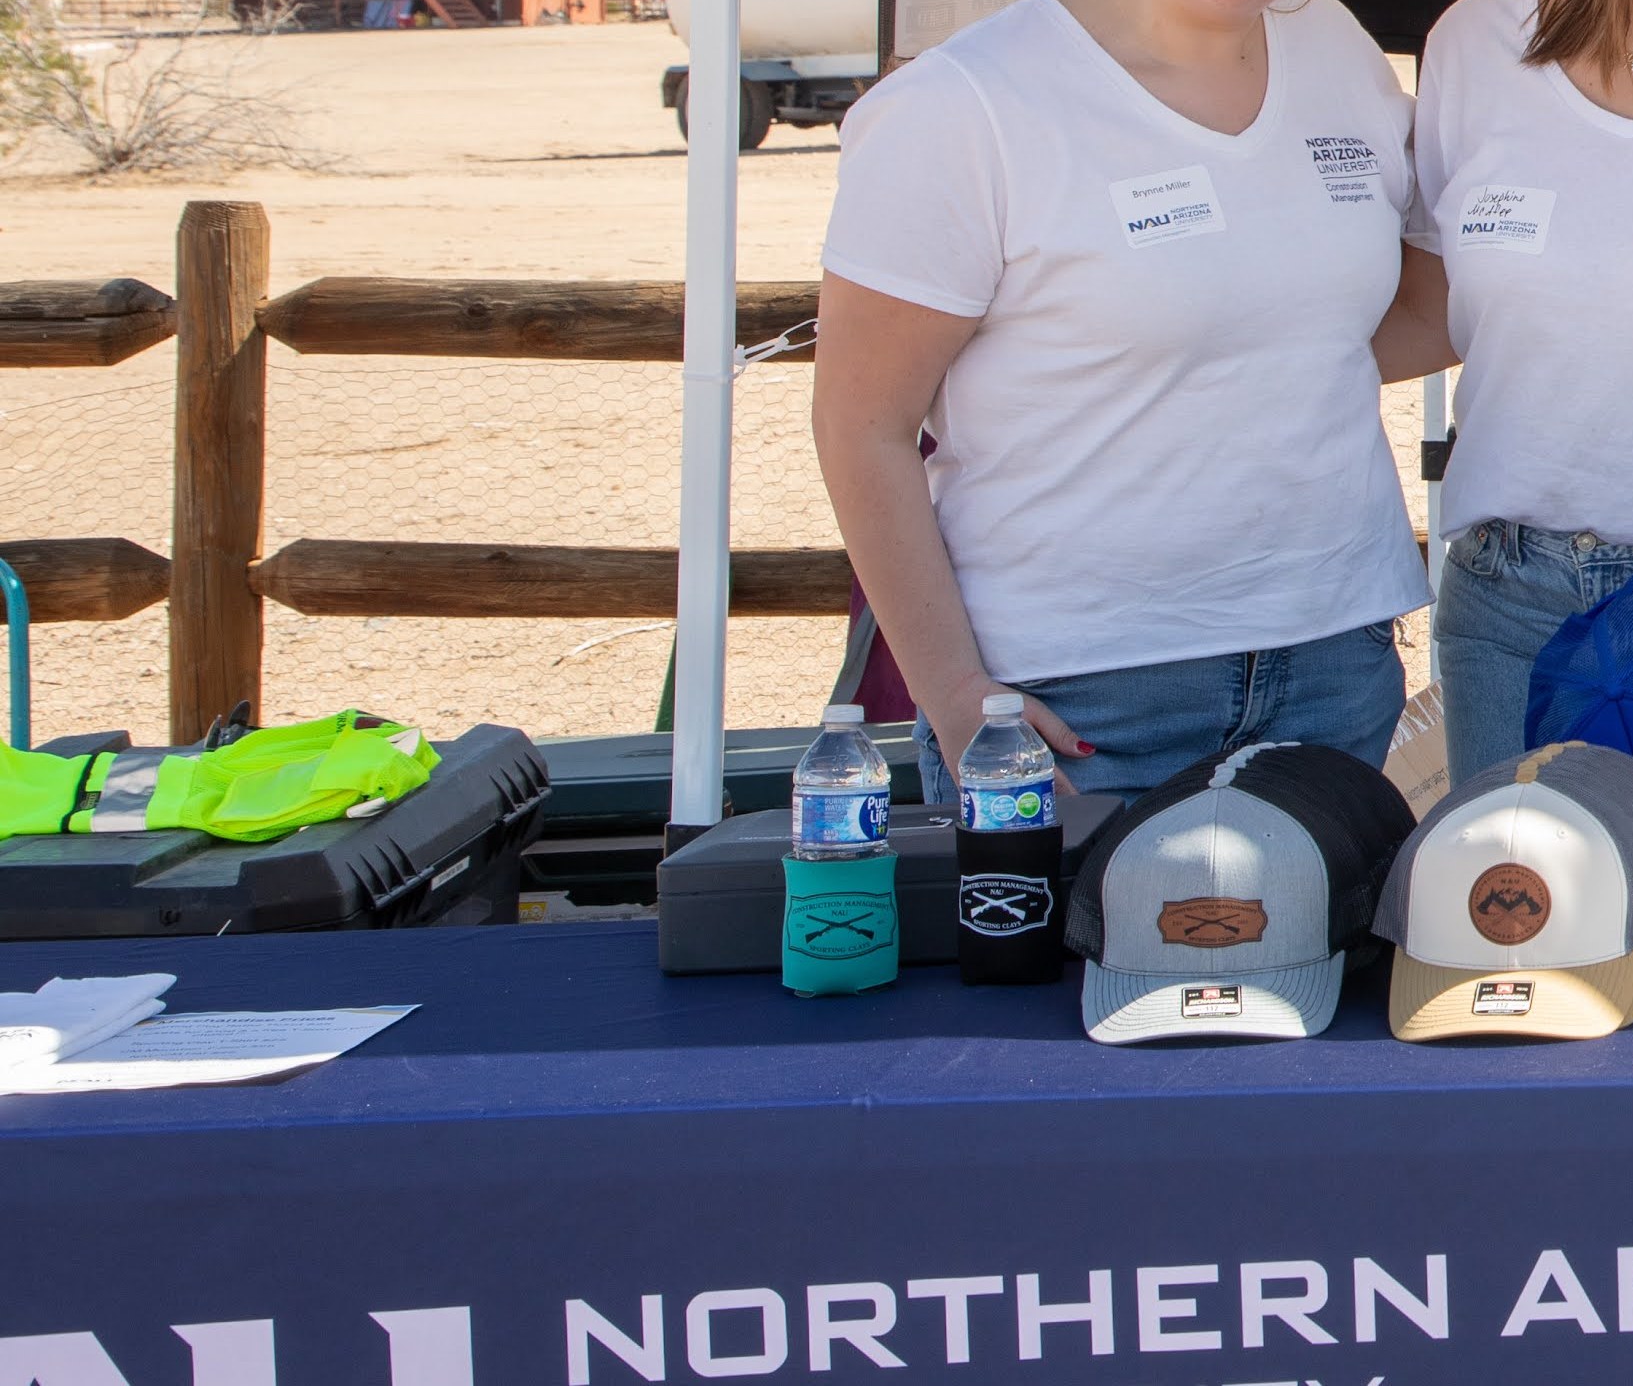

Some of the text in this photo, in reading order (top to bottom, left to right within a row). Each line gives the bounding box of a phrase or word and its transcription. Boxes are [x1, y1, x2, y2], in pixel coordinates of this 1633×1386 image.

[1305, 137, 1365, 148] NORTHERN
[1313, 147, 1375, 162] ARIZONA
[1317, 159, 1379, 173] UNIVERSITY
[1132, 181, 1191, 198] Brynne Miller
[1325, 182, 1368, 192] Construction
[1331, 194, 1374, 204] Management
[1128, 214, 1170, 232] NAU
[1462, 222, 1495, 234] NAU
[867, 795, 889, 811] Pure
[870, 809, 888, 826] Life
[1000, 881, 1044, 895] MANAGEMENT
[973, 919, 1022, 929] SPORTING CLAYS
[567, 1254, 1449, 1385] NORTHERN
